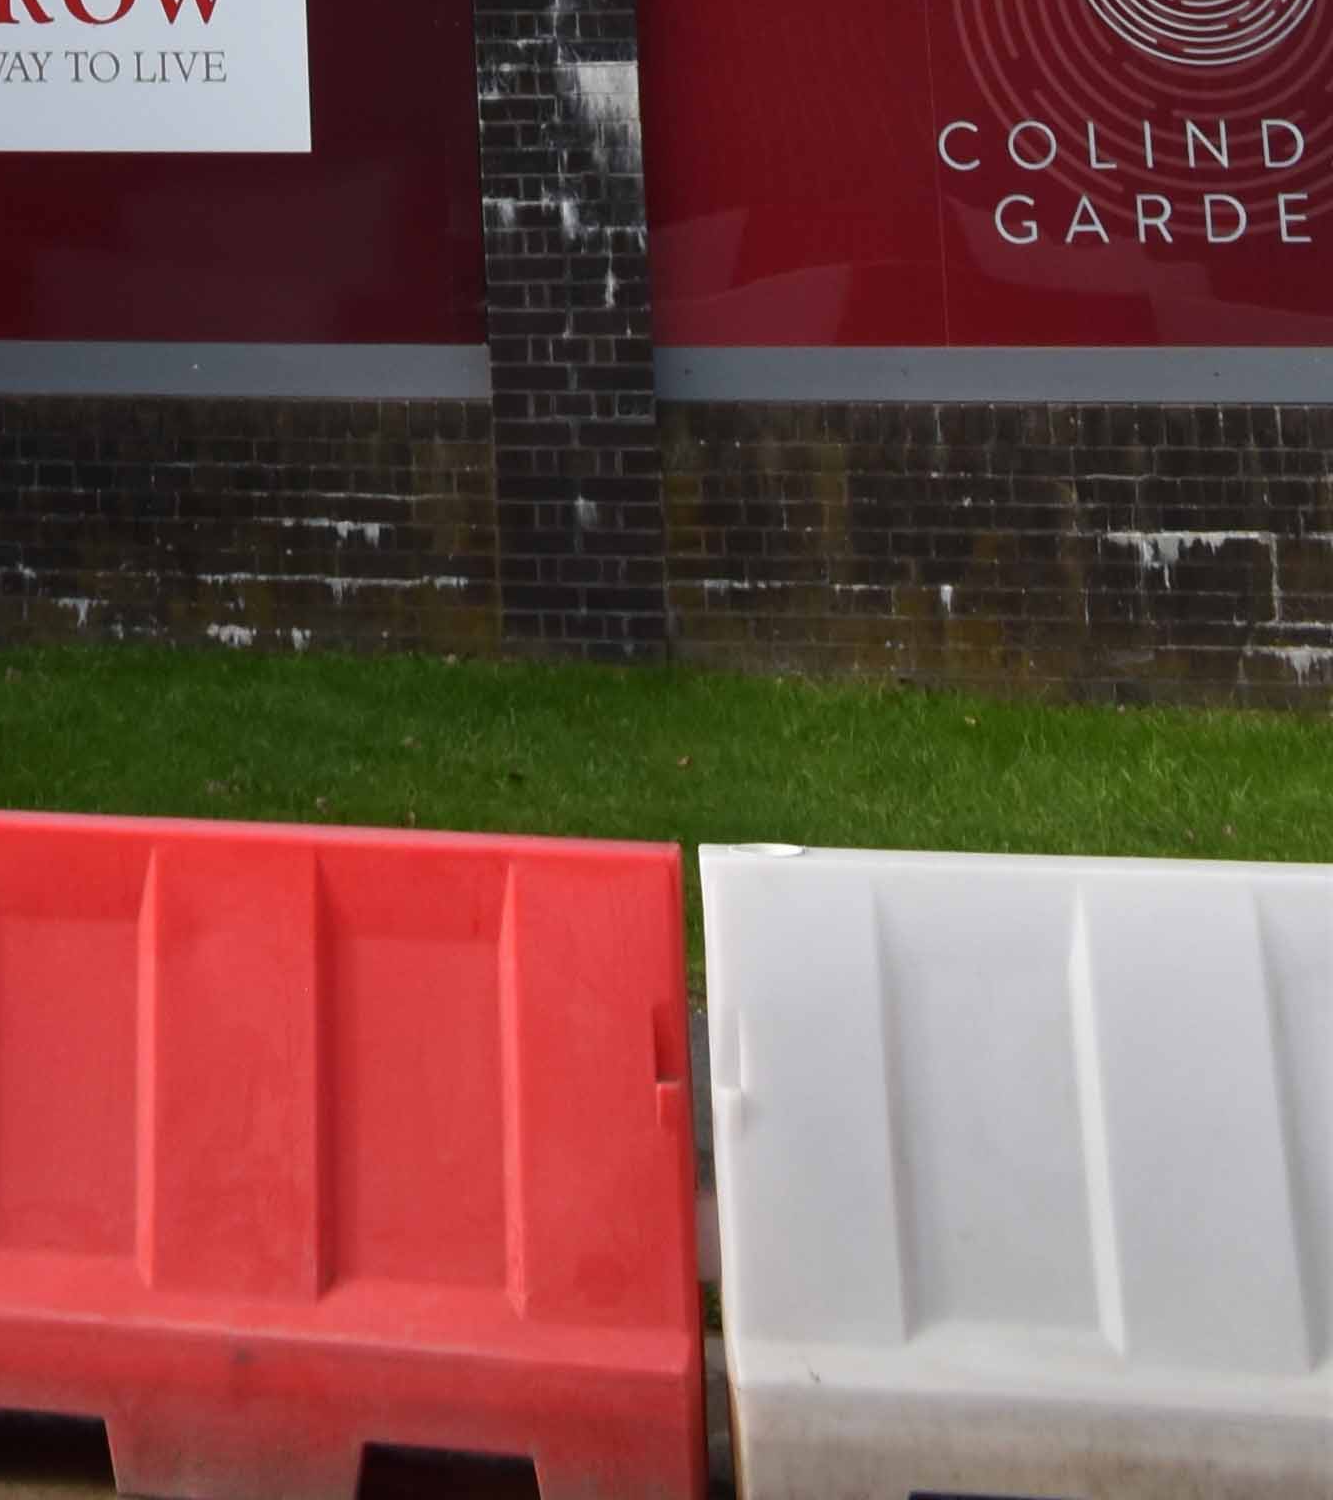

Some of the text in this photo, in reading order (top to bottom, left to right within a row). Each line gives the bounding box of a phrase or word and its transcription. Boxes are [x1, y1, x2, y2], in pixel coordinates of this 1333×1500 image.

[64, 51, 121, 84] TO
[134, 51, 227, 84] LIVE
[938, 119, 1305, 170] COLIND
[994, 193, 1312, 244] GARDE
